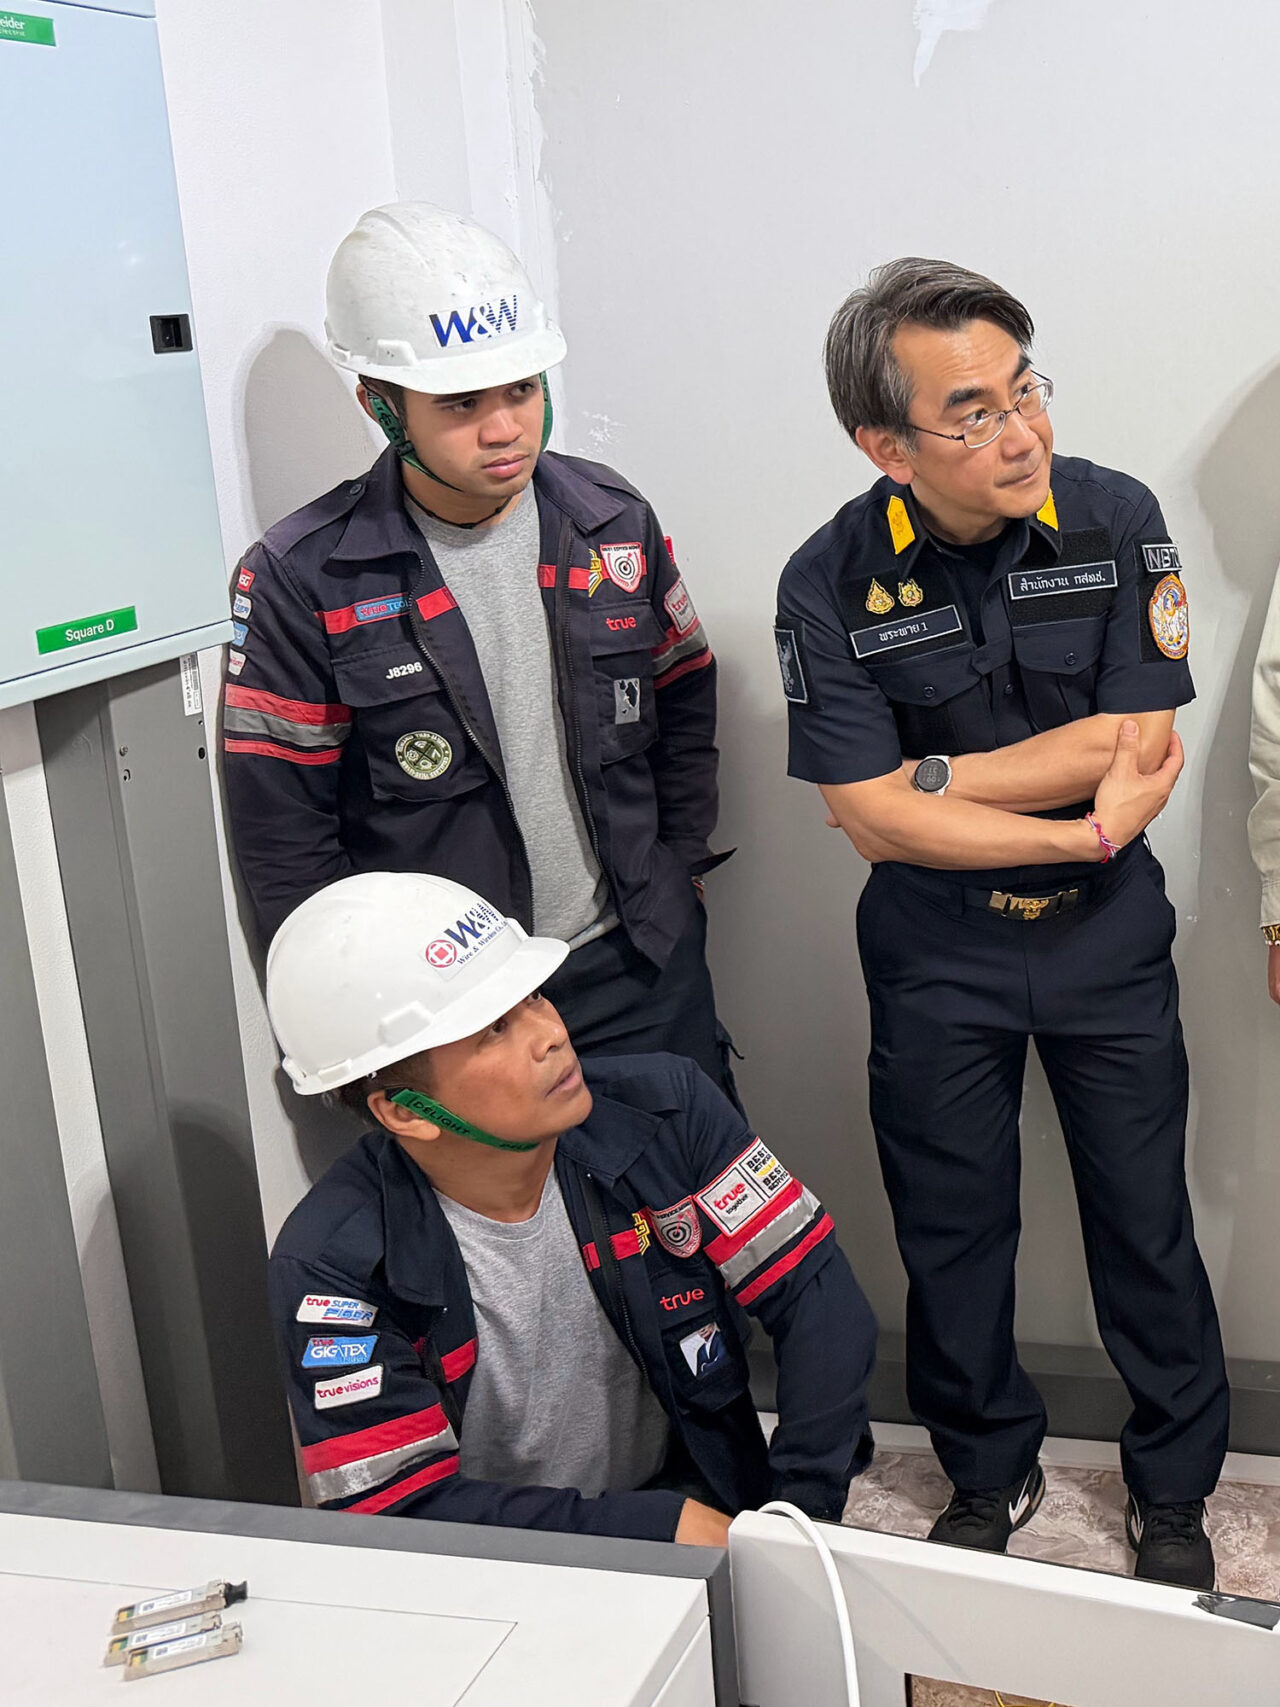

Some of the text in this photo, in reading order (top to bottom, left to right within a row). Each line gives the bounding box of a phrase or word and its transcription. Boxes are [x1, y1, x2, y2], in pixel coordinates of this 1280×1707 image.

[429, 295, 517, 348] W&W
[1147, 549, 1180, 569] NBT
[1020, 576, 1069, 592] สำนักงาน
[65, 619, 115, 642] Square D
[606, 616, 637, 631] true
[879, 624, 920, 642] พระพาย
[386, 661, 423, 680] J8296
[412, 1101, 472, 1136] DELIGHT
[746, 1147, 768, 1169] BEST
[713, 1182, 746, 1210] true
[306, 1297, 360, 1309] true SUPER
[660, 1288, 705, 1311] true
